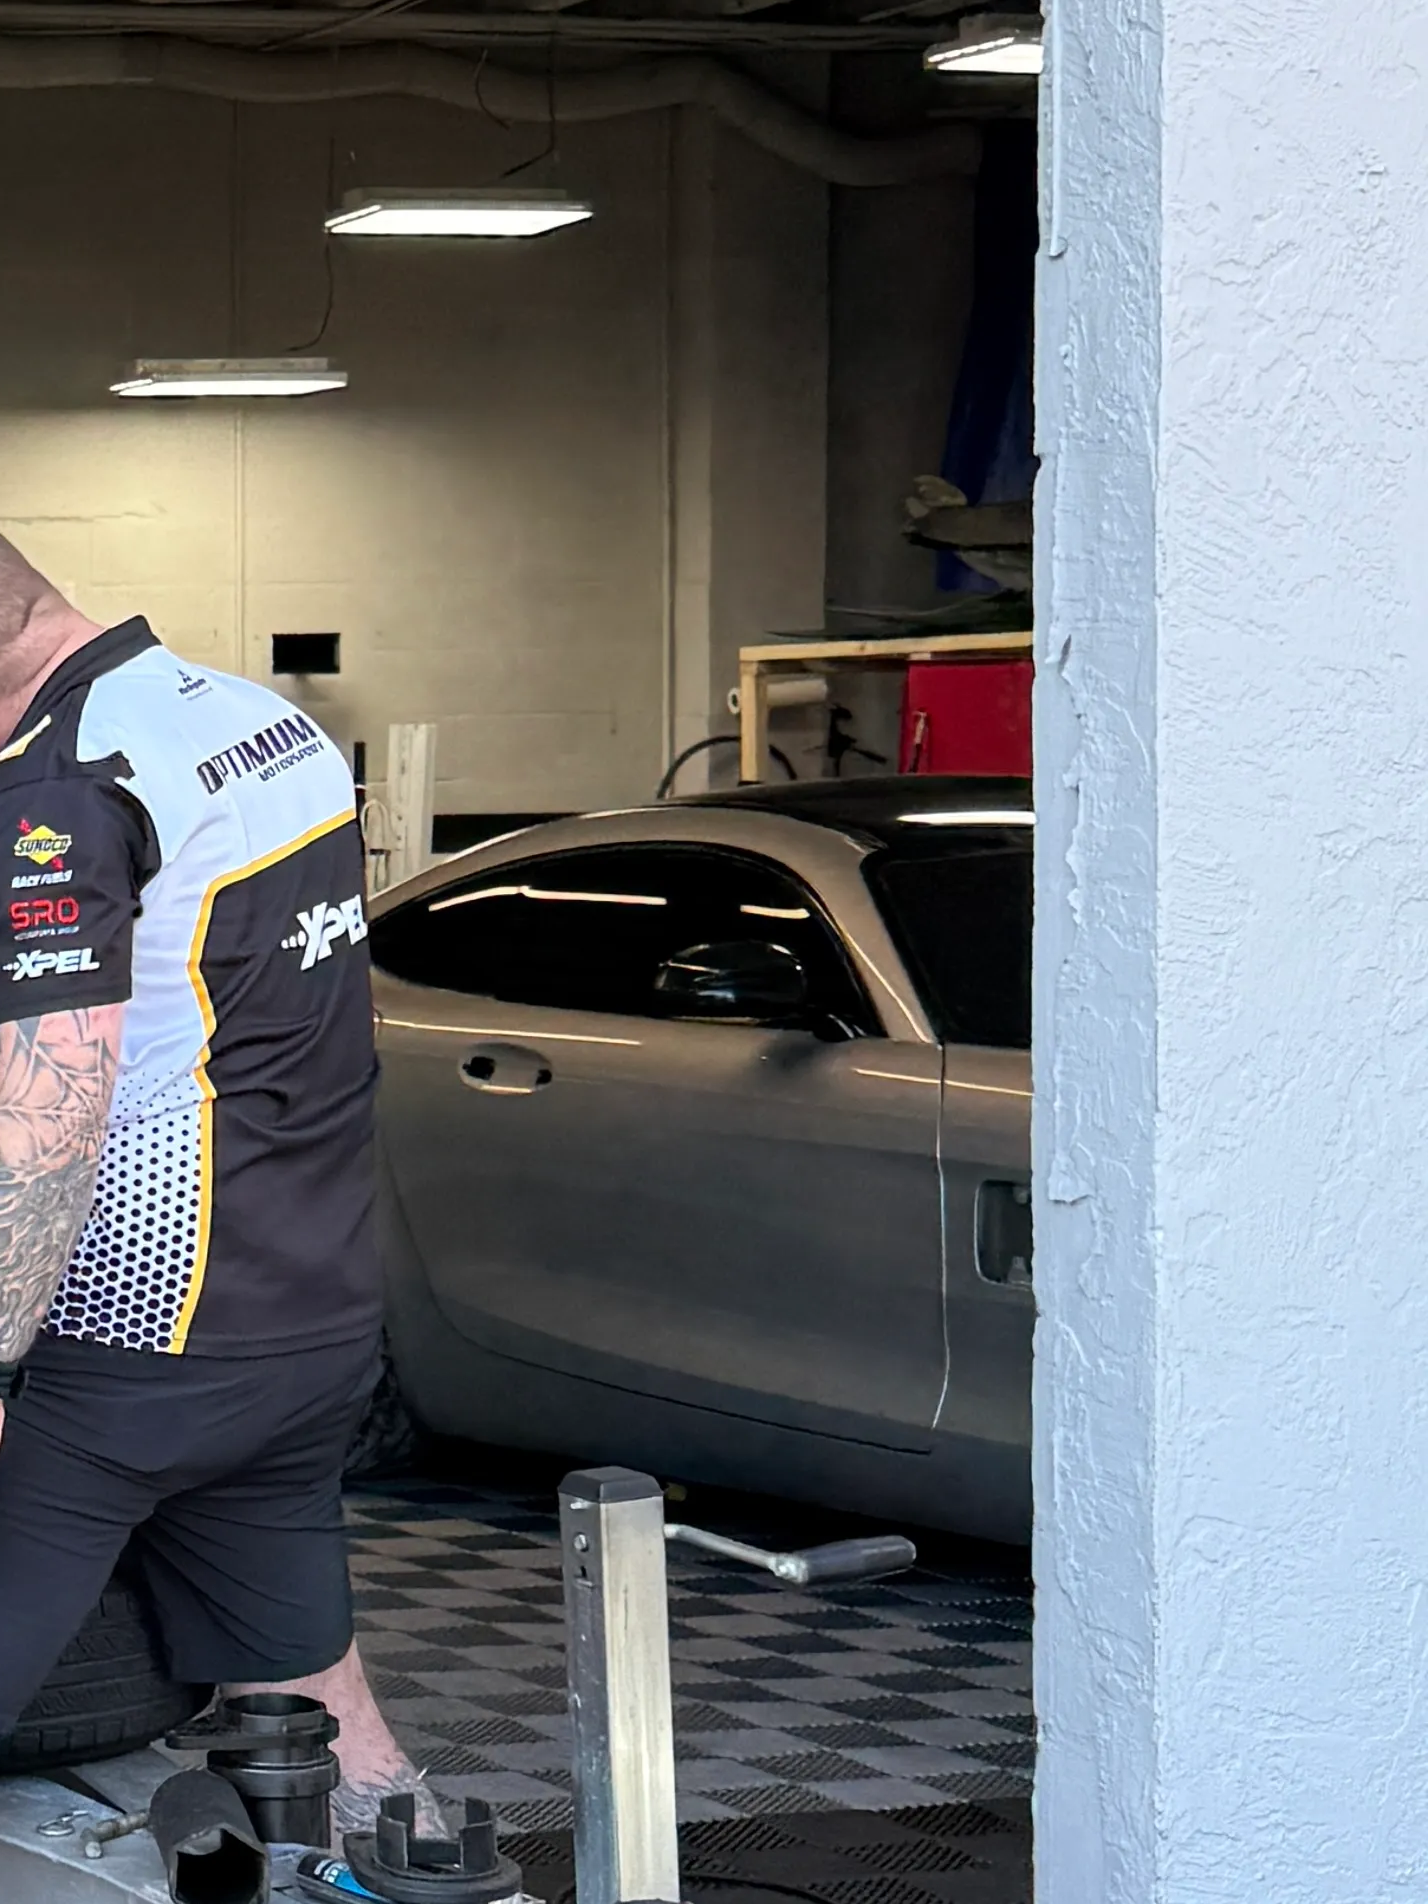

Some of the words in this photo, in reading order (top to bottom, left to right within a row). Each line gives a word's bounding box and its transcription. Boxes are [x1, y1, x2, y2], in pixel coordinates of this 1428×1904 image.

[196, 713, 318, 795] OPTIMUM
[16, 837, 70, 854] SUNOCO
[10, 897, 80, 930] SRO
[11, 948, 100, 981] XPEL
